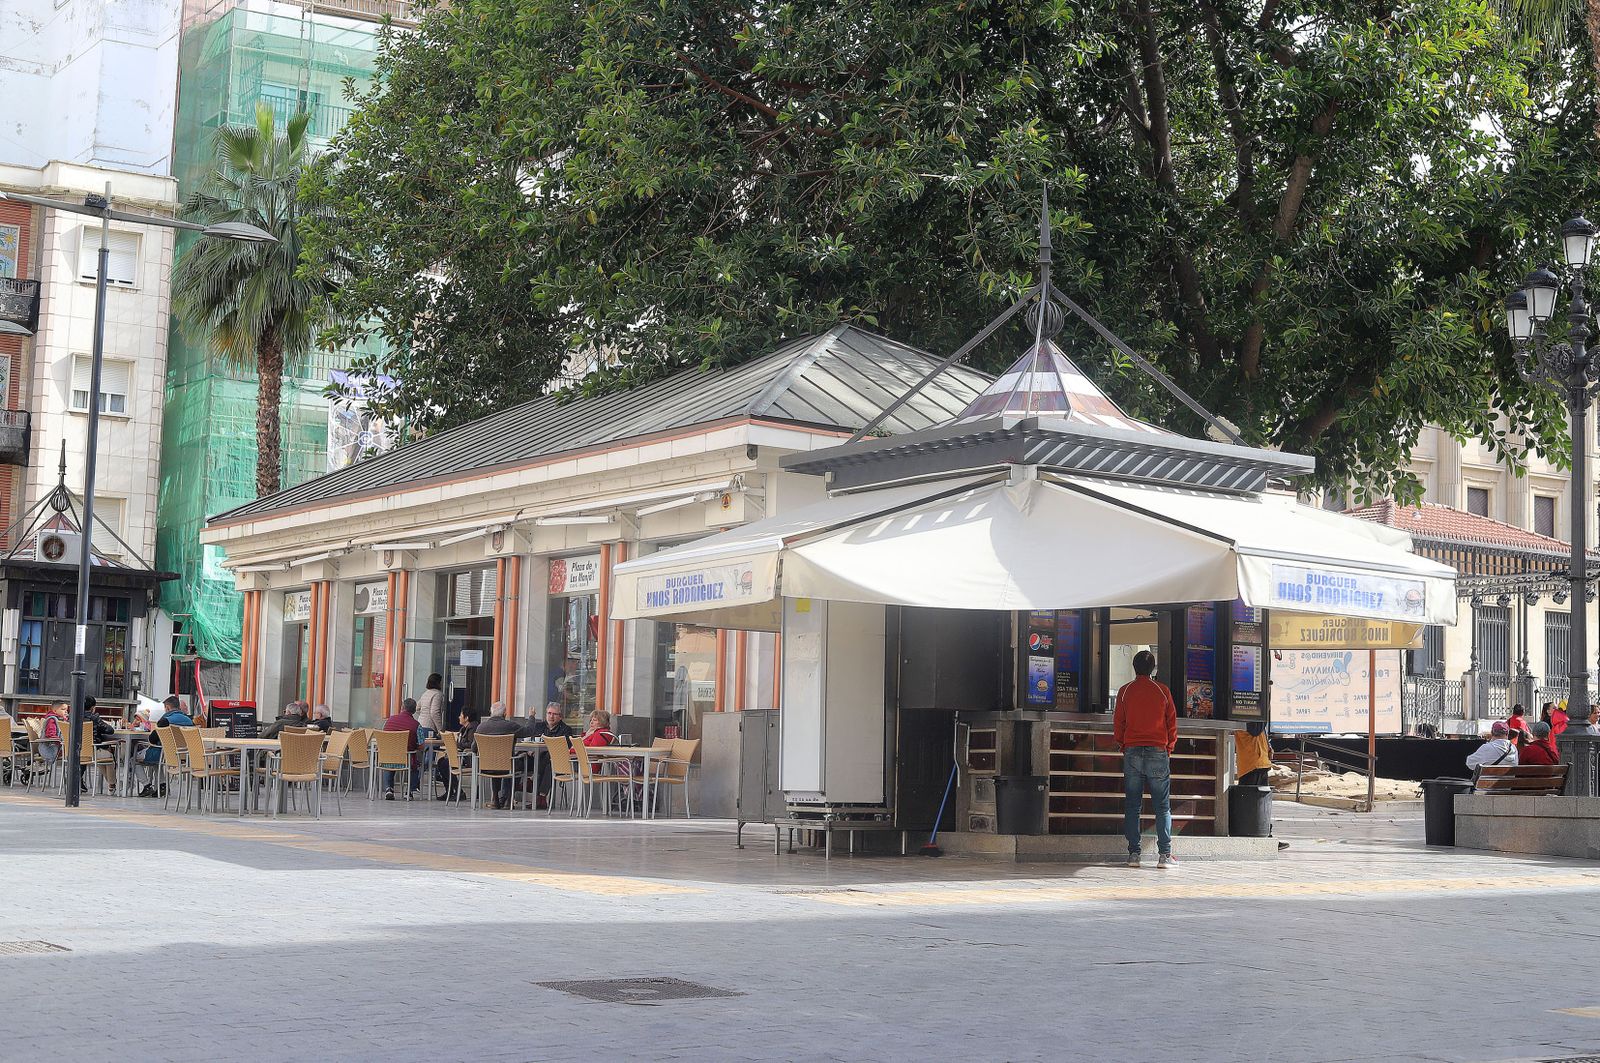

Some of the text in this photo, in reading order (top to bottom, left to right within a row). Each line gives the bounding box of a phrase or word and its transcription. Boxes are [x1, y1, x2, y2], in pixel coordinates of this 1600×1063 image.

[666, 574, 704, 589] BURGUER
[1306, 573, 1357, 589] BURGUER
[672, 582, 724, 605] RODRIGUEZ
[1278, 582, 1384, 609] HNOS RODRIGUEZ
